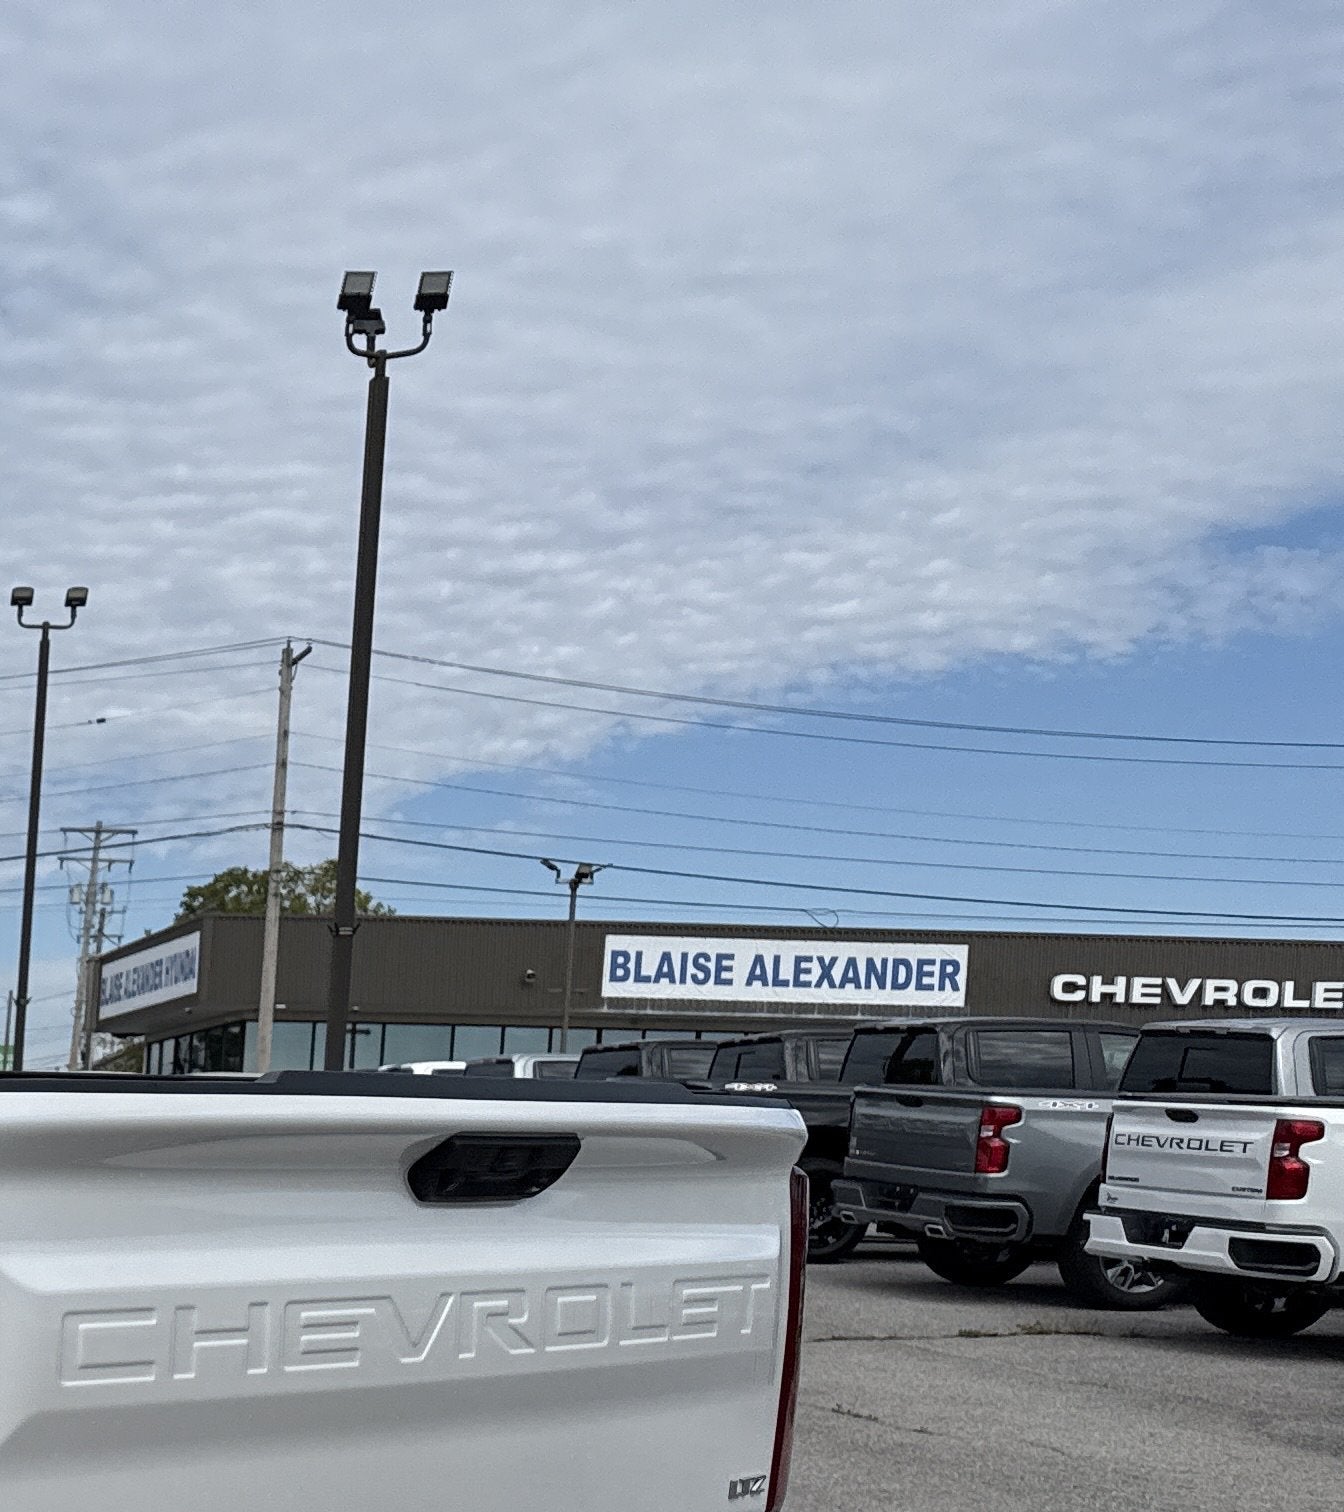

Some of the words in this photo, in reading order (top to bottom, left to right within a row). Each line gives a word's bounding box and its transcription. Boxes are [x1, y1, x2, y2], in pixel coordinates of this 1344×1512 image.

[608, 949, 735, 986] BLAISE
[745, 953, 961, 992] ALEXANDER
[1050, 973, 1344, 1009] CHEVROLE
[1114, 1133, 1255, 1154] CHEVROLET
[61, 1273, 772, 1388] CHEVROLET
[727, 1474, 767, 1501] LTZ
